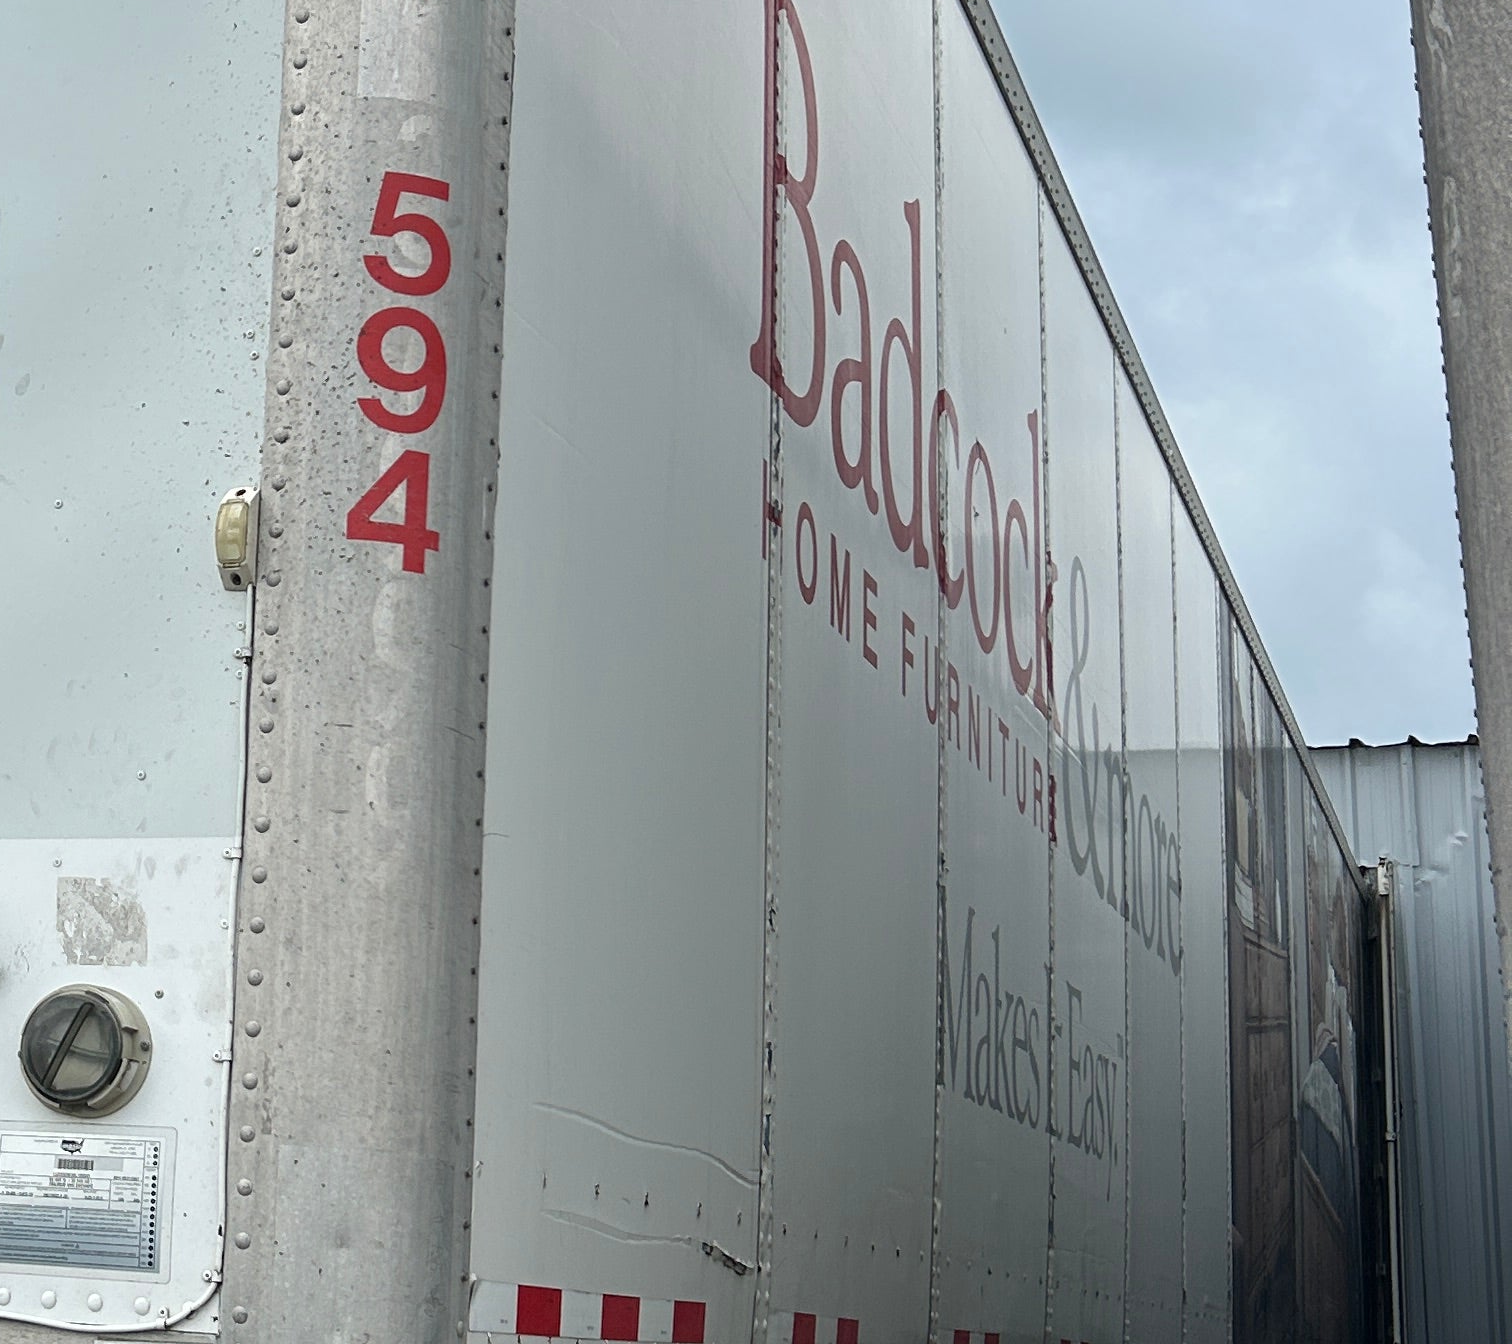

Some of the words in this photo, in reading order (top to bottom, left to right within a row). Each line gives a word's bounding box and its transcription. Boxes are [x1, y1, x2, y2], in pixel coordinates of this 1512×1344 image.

[346, 170, 452, 575] 594
[762, 458, 879, 671] HOME
[936, 883, 1040, 1131] Makes
